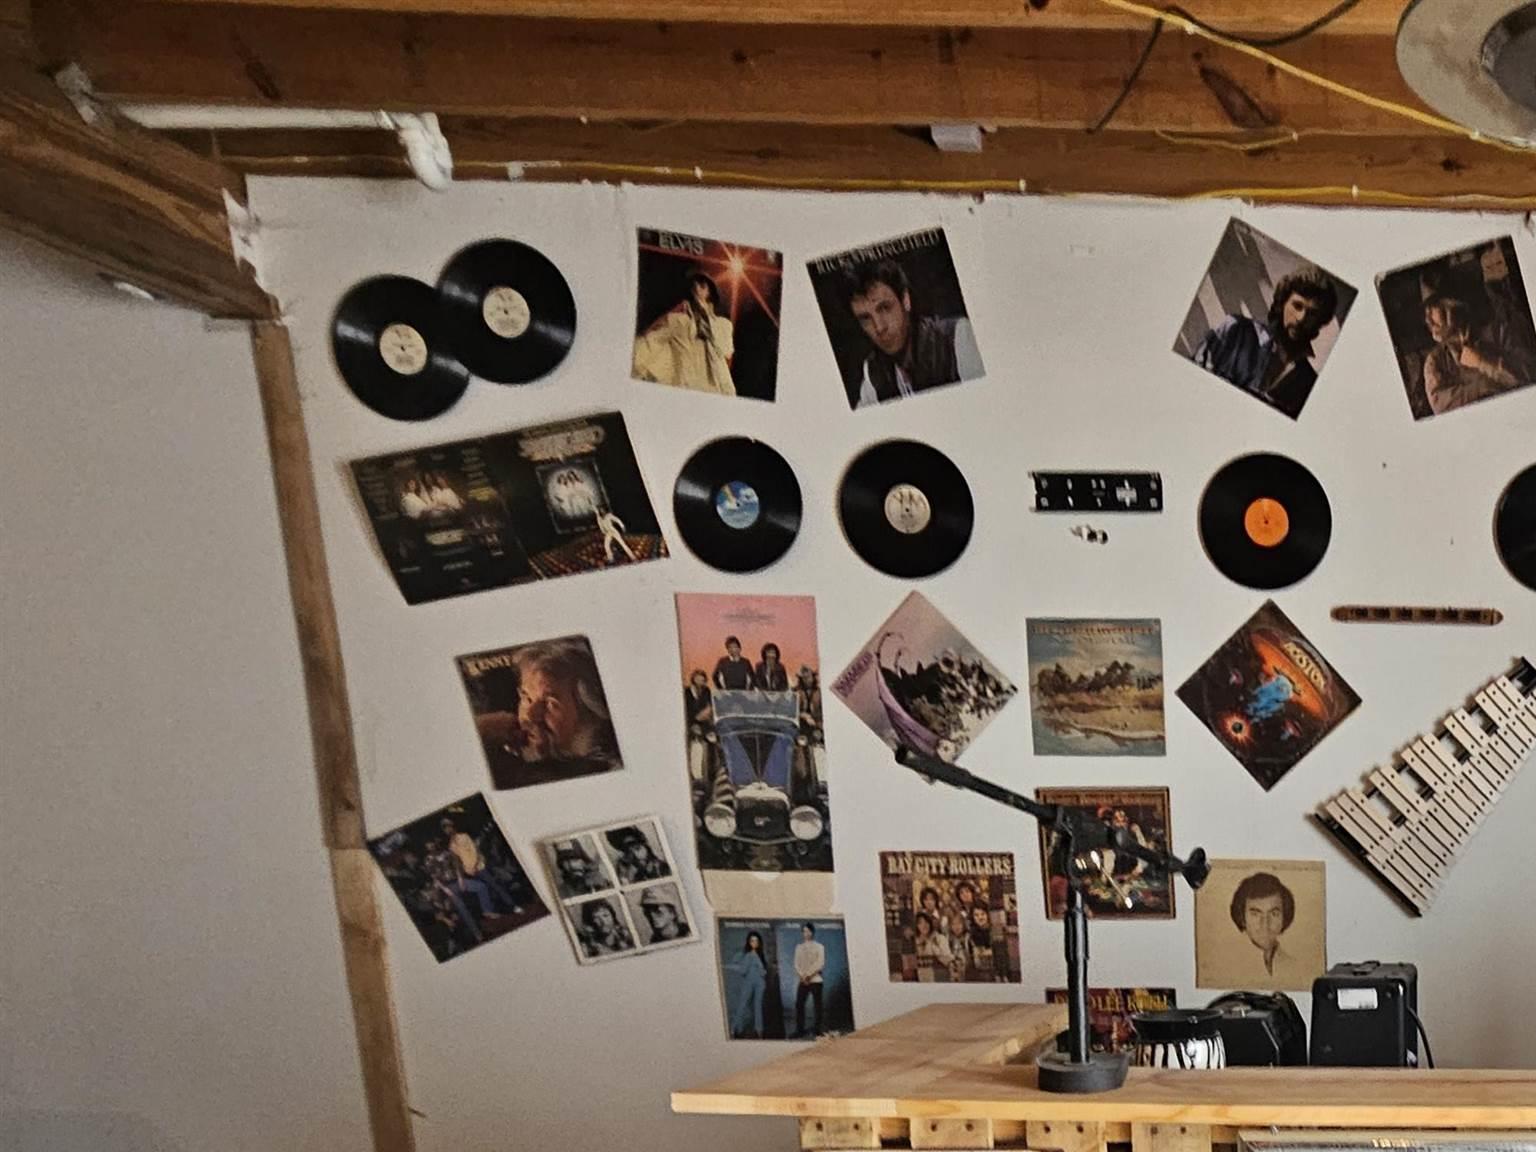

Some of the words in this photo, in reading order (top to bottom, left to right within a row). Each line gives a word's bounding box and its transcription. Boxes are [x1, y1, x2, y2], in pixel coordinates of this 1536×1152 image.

[659, 230, 704, 255] ELVIS
[466, 655, 512, 677] KENNY
[1283, 641, 1325, 689] BOSTON
[887, 855, 914, 874] BAY
[914, 855, 948, 874] CITY
[949, 855, 1012, 875] ROLLERS
